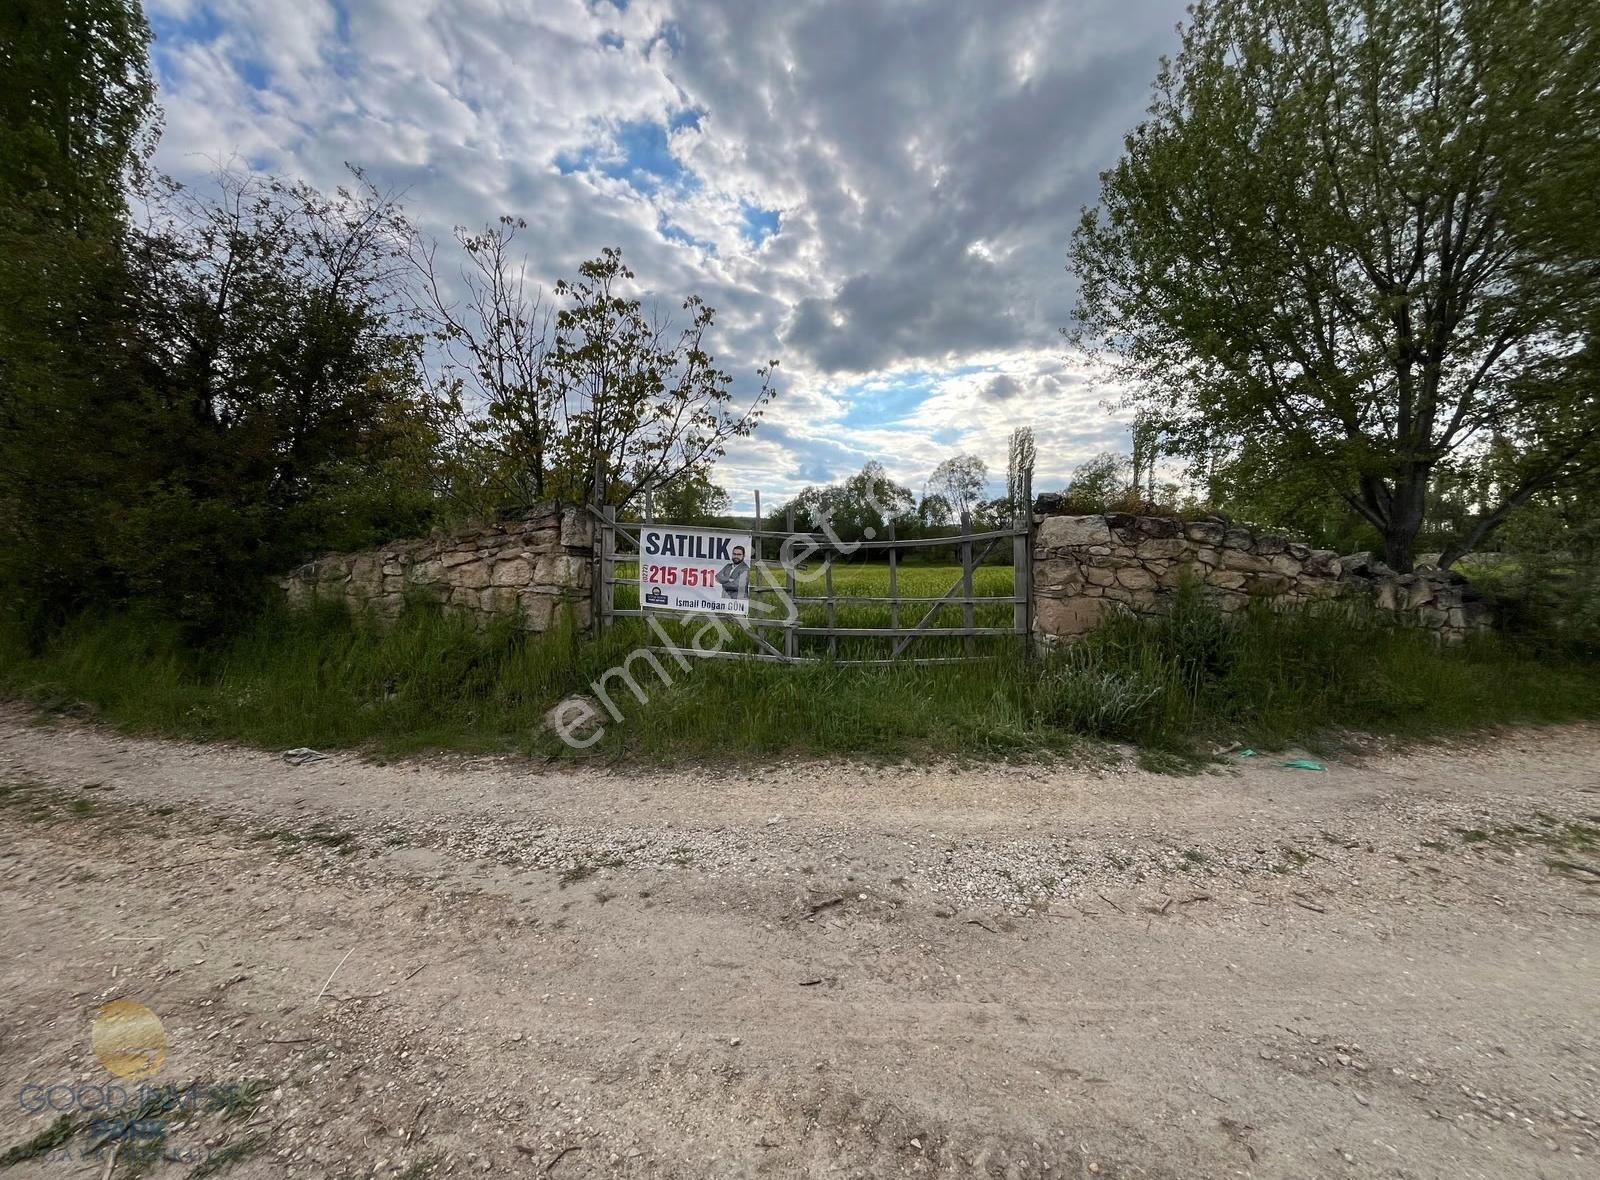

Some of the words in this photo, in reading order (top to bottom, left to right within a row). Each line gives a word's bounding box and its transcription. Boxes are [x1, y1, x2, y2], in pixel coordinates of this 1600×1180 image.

[645, 532, 731, 560] SATILIK
[649, 565, 677, 585] 215
[681, 567, 699, 586] 15
[700, 569, 715, 588] 11
